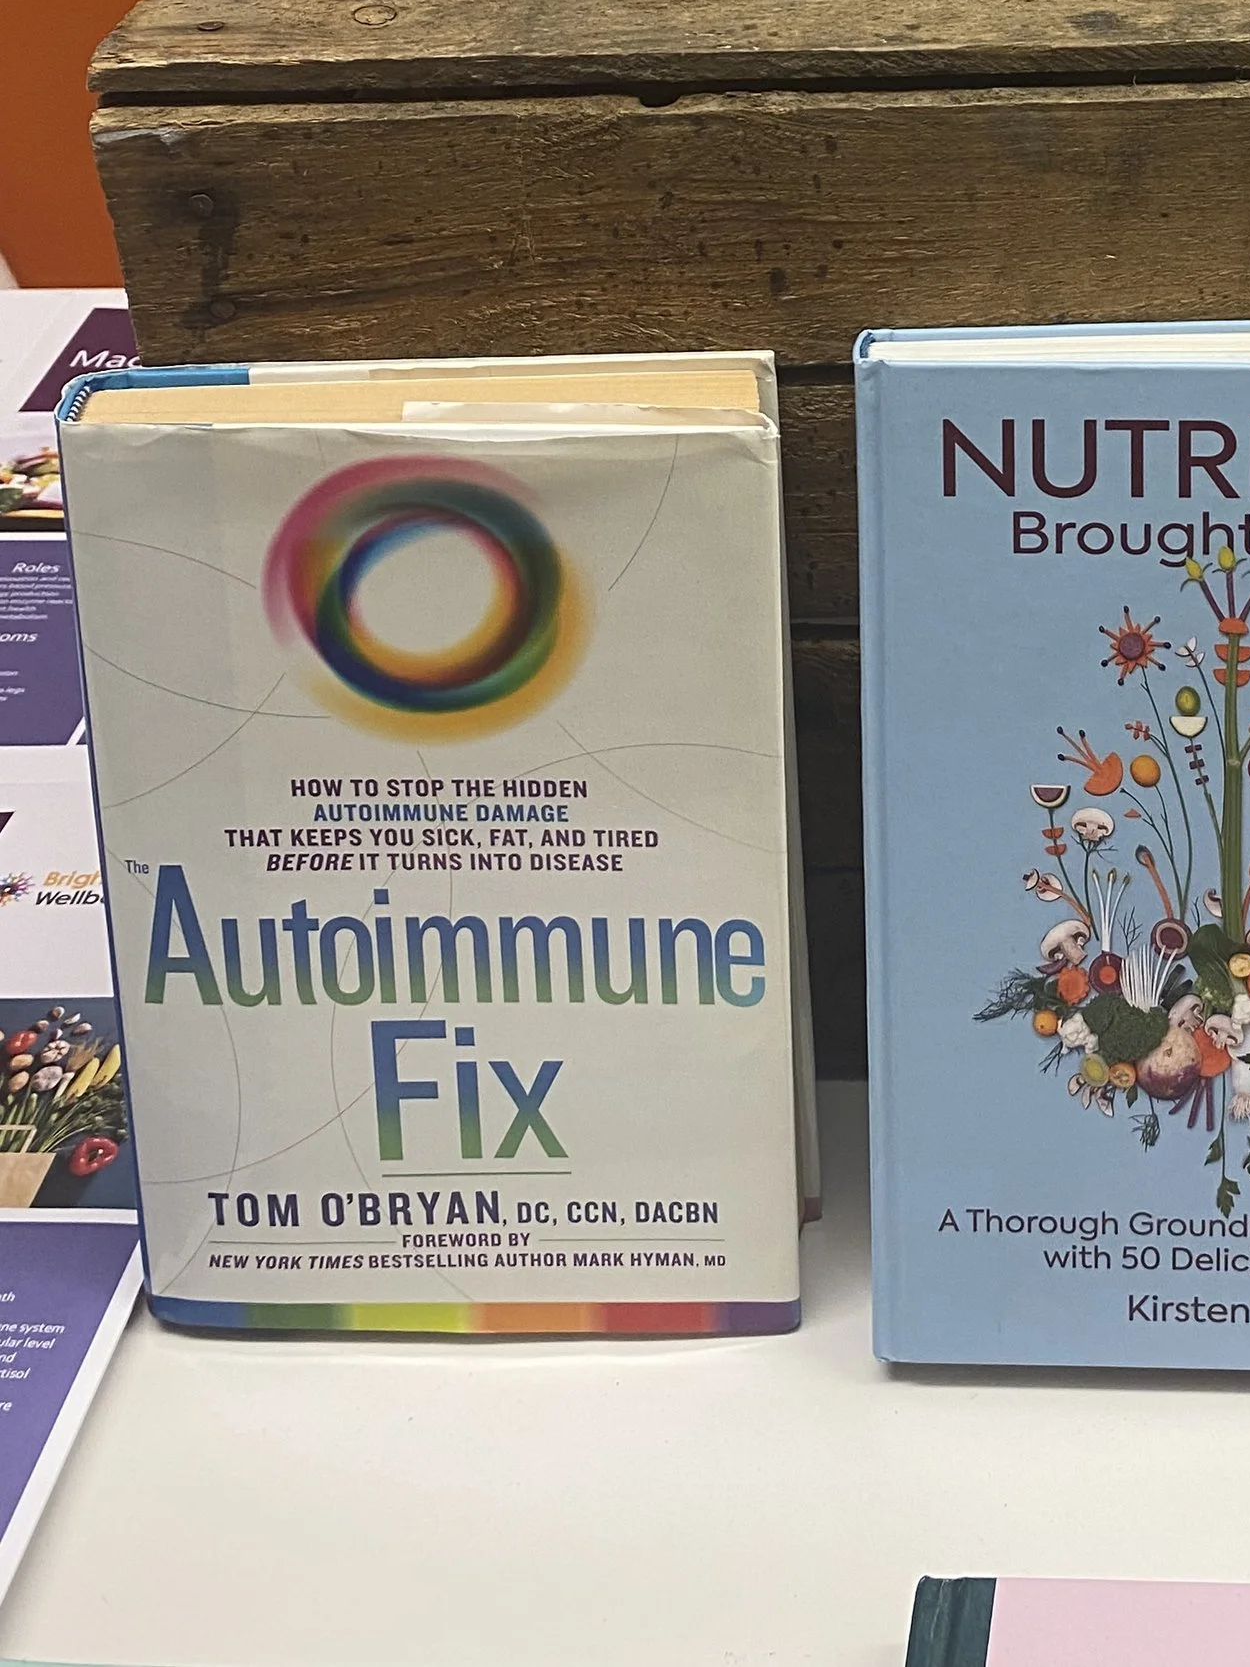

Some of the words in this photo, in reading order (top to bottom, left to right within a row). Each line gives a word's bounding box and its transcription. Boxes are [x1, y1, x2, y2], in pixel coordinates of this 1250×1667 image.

[12, 562, 60, 573] Roles
[290, 779, 344, 799] HOW
[350, 779, 380, 798] TO
[386, 779, 445, 798] STOP
[451, 779, 497, 798] THE
[503, 779, 587, 798] HIDDEN
[313, 803, 468, 823] AUTOIMMUNE
[475, 804, 569, 823] DAMAGE
[224, 828, 283, 847] THAT
[290, 828, 363, 848] KEEPS
[369, 828, 416, 847] YOU
[421, 828, 482, 850] SICK,
[489, 829, 534, 850] FAT,
[540, 829, 586, 847] AND
[593, 829, 658, 848] TIRED
[124, 859, 150, 875] The
[266, 852, 355, 872] BEFORE
[359, 853, 381, 872] IT
[387, 853, 463, 872] TURNS
[470, 853, 522, 872] INTO
[529, 854, 624, 872] DISEASE
[145, 864, 766, 1008] Autoimmune
[370, 1019, 569, 1162] Fix
[208, 1191, 299, 1228] TOM
[320, 1190, 507, 1228] O'BRYAN,
[517, 1201, 557, 1226] DC,
[566, 1200, 626, 1226] CCN,
[634, 1201, 719, 1224] DACBN
[937, 1210, 959, 1233] A
[966, 1208, 1119, 1241] Thorough
[402, 1233, 503, 1248] FOREWORD
[509, 1233, 531, 1247] BY
[209, 1254, 249, 1269] NEW
[254, 1254, 302, 1270] YORK
[308, 1254, 364, 1270] TIMES
[368, 1254, 489, 1269] BESTSELLING
[494, 1254, 567, 1268] AUTHOR
[572, 1253, 625, 1268] MARK
[630, 1253, 699, 1269] HYMAN,
[704, 1255, 726, 1267] MD
[1043, 1245, 1112, 1271] with
[1121, 1246, 1161, 1271] 50
[1127, 1294, 1250, 1324] Kirsten
[19, 1323, 65, 1334] system
[23, 1337, 56, 1349] level
